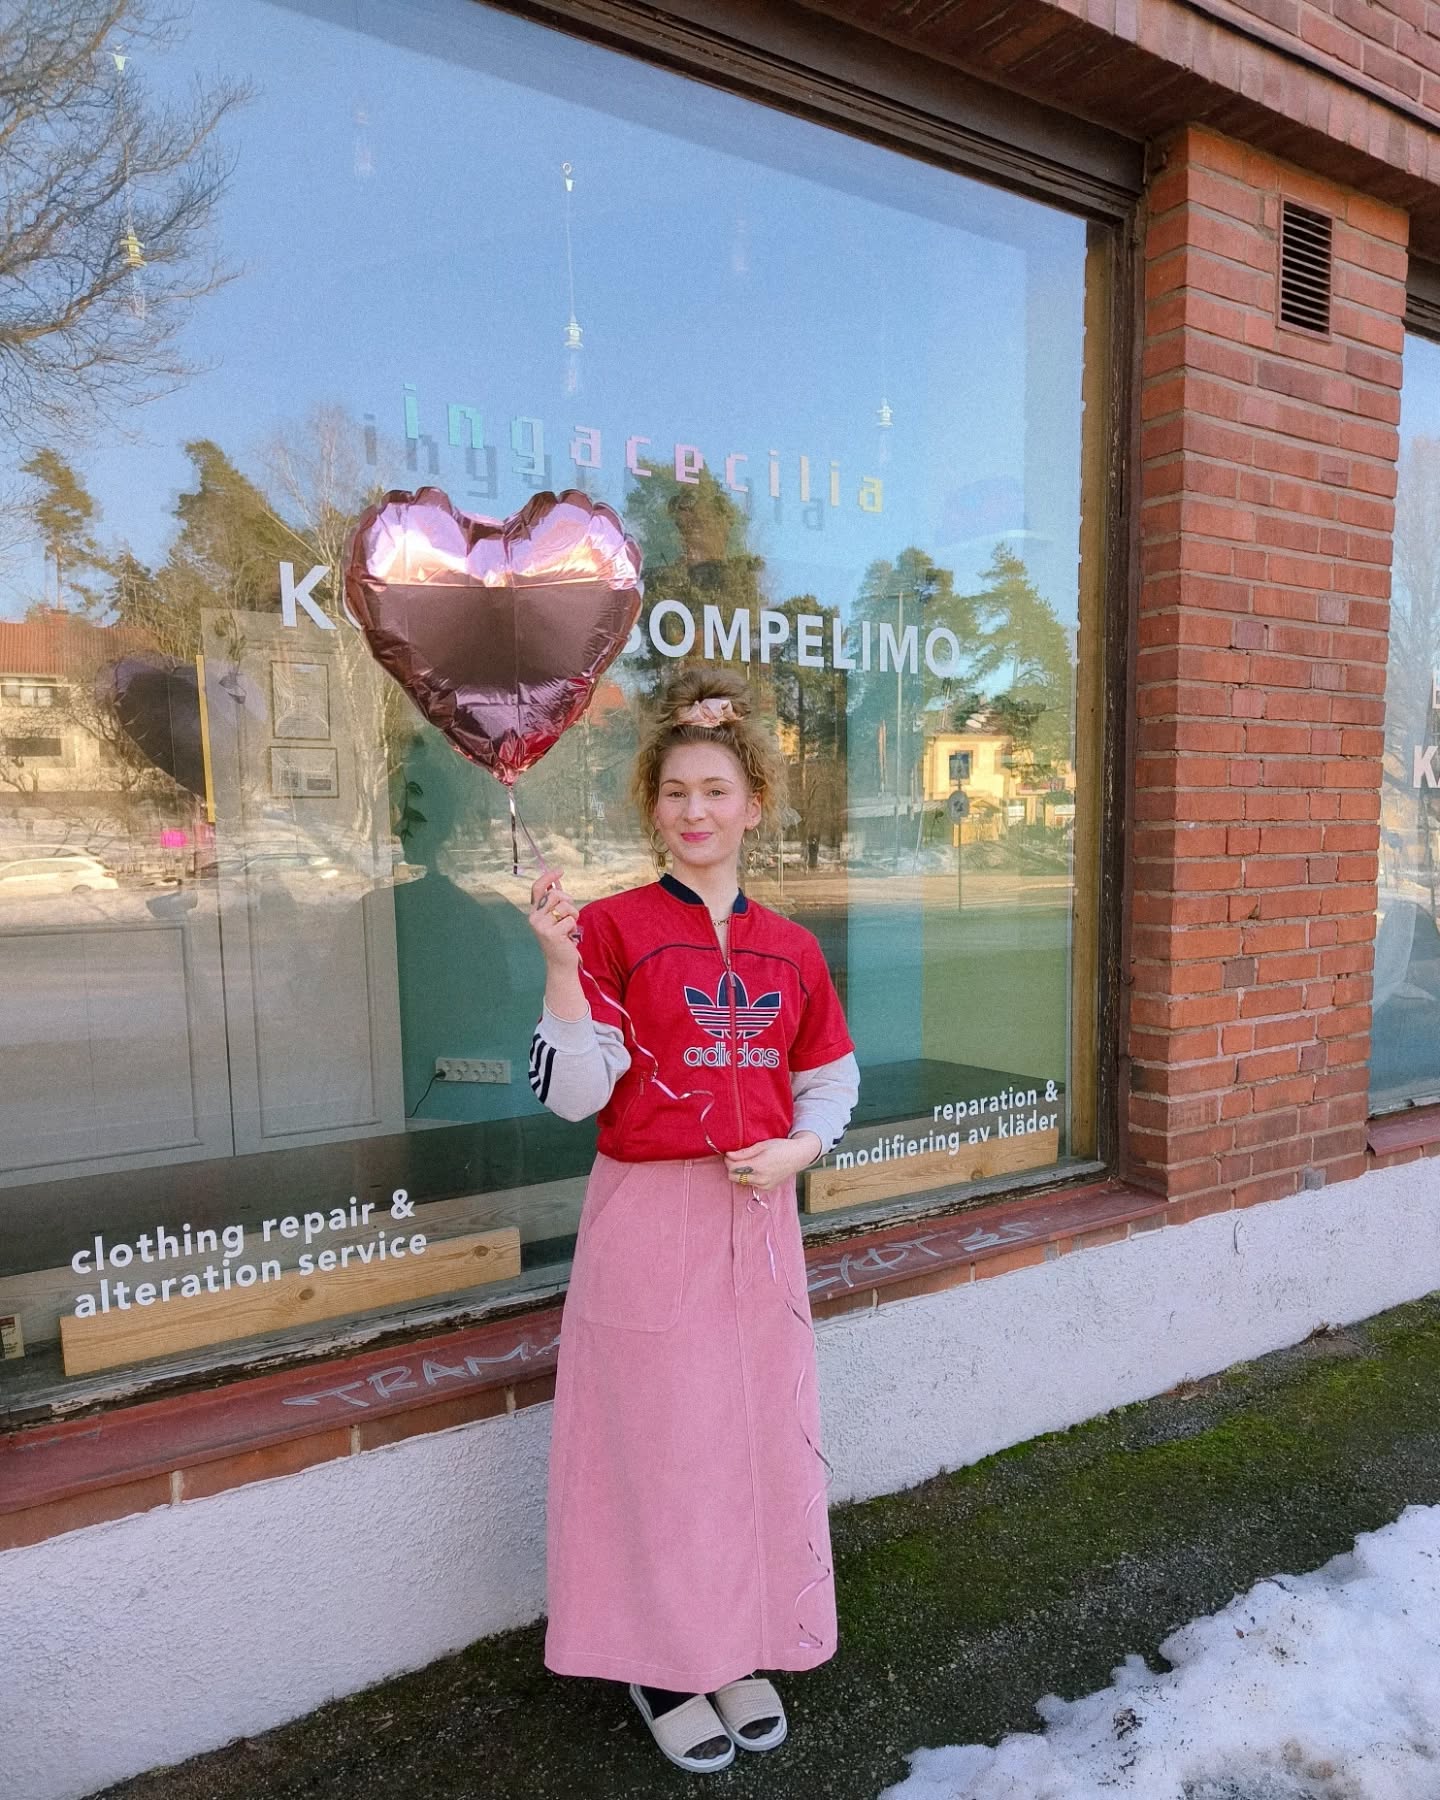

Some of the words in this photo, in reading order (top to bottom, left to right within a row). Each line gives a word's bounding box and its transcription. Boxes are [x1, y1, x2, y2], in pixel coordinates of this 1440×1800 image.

[1413, 744, 1440, 789] K
[684, 1041, 780, 1068] adidas
[933, 1086, 1037, 1125] reparation
[1045, 1079, 1059, 1102] &
[835, 1129, 961, 1170] modifiering
[968, 1125, 991, 1145] av
[998, 1110, 1058, 1140] kläder
[71, 1223, 244, 1275] clothing
[262, 1196, 375, 1244] repair
[390, 1188, 416, 1220] &
[74, 1258, 282, 1319] alteration
[299, 1230, 428, 1276] service
